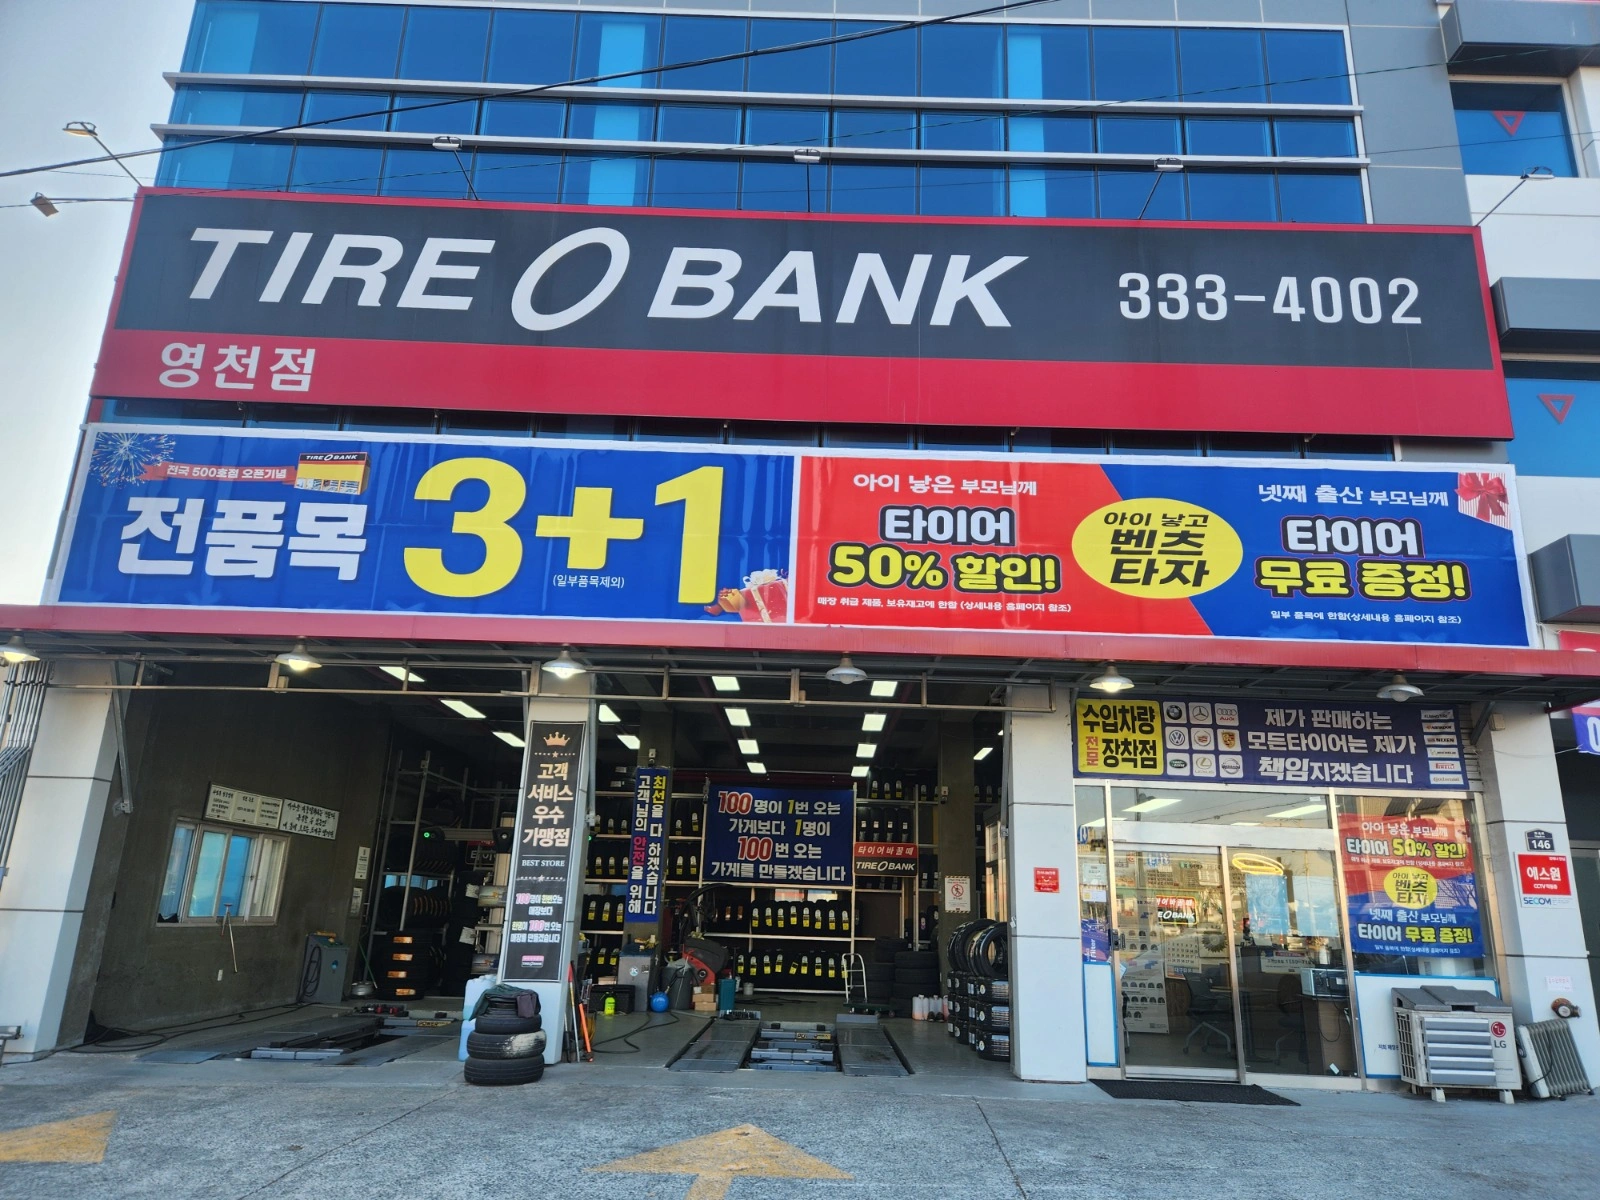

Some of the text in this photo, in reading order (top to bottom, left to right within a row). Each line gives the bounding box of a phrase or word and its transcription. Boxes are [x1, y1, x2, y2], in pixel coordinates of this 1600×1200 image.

[189, 227, 496, 311] TIRE
[646, 246, 1030, 328] BANK
[1118, 272, 1422, 325] 333-4002
[158, 342, 317, 392] 영천점
[166, 464, 191, 477] 전국
[241, 468, 288, 480] 오픈기념
[853, 473, 1037, 496] 아이 낳은 부모님께
[1258, 484, 1449, 507] 넷째 출산 부모님께
[883, 507, 1013, 546] 타이어
[1103, 511, 1209, 528] 아이 낳고
[117, 496, 368, 582] 전품목
[403, 457, 725, 606] 3+1
[1285, 518, 1420, 556] 타이어
[1110, 529, 1206, 556] 벤츠
[832, 544, 1057, 592] 50% 할인!
[1110, 558, 1210, 588] 타자
[552, 574, 625, 589] (일부품목제외)
[1259, 560, 1467, 599] 무료 증정!
[1082, 704, 1156, 735] 수입차량
[1264, 707, 1393, 730] 제가 판매하는
[1101, 737, 1158, 769] 장착점
[1247, 731, 1417, 755] 모든타이어는 제가
[536, 761, 569, 781] 고객
[1258, 755, 1415, 784] 책임지겠습니다
[527, 783, 574, 803] 서비스
[650, 775, 667, 819] 최선을
[532, 805, 565, 825] 우수
[787, 799, 809, 816] 1번
[812, 801, 841, 816] 오는
[522, 827, 571, 848] 가맹점
[728, 818, 831, 837] 가게보다 1명이
[1361, 821, 1385, 835] 아이
[627, 775, 651, 915] 고객님의 안전을 위해
[793, 843, 822, 860] 오는
[1345, 837, 1467, 859] 타이어 50% 할인!
[1531, 839, 1551, 850] 146
[521, 859, 540, 867] BEST
[711, 861, 847, 882] 가게를 만들겠습니다
[1526, 866, 1562, 881] 에스원
[1395, 879, 1428, 893] 벤츠
[1396, 892, 1429, 906] 타자
[1523, 896, 1552, 906] SECOM
[1369, 908, 1457, 924] 넷째 출산 부모님께
[1357, 923, 1473, 944] 타이어 무료 증정!
[1494, 1040, 1507, 1049] LG
